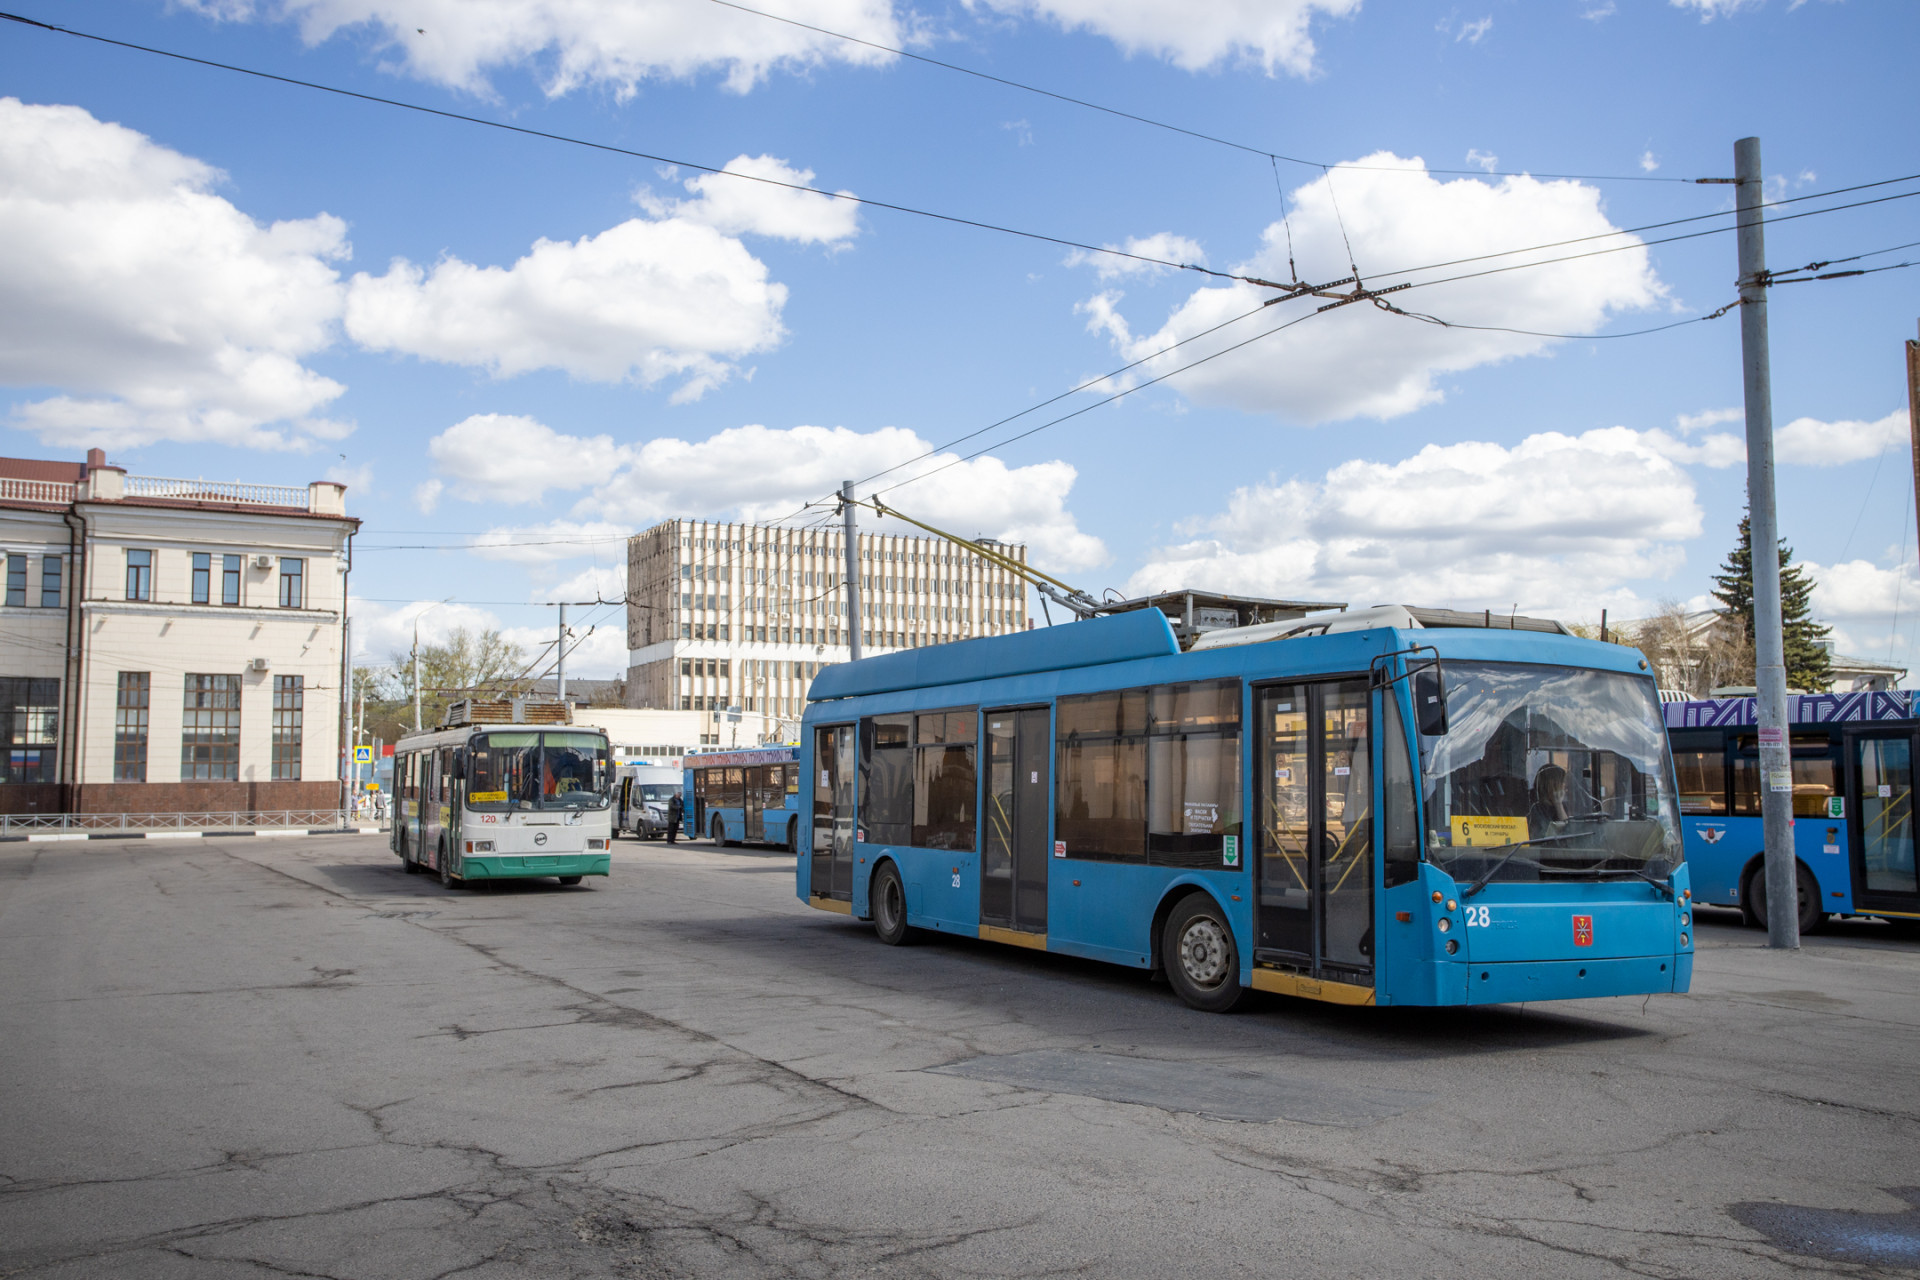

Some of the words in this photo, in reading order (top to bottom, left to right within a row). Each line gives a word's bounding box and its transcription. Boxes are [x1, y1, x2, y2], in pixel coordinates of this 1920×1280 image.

[480, 815, 496, 823] 120
[1462, 822, 1470, 836] 6
[952, 874, 960, 888] 28
[1466, 906, 1490, 927] 28
